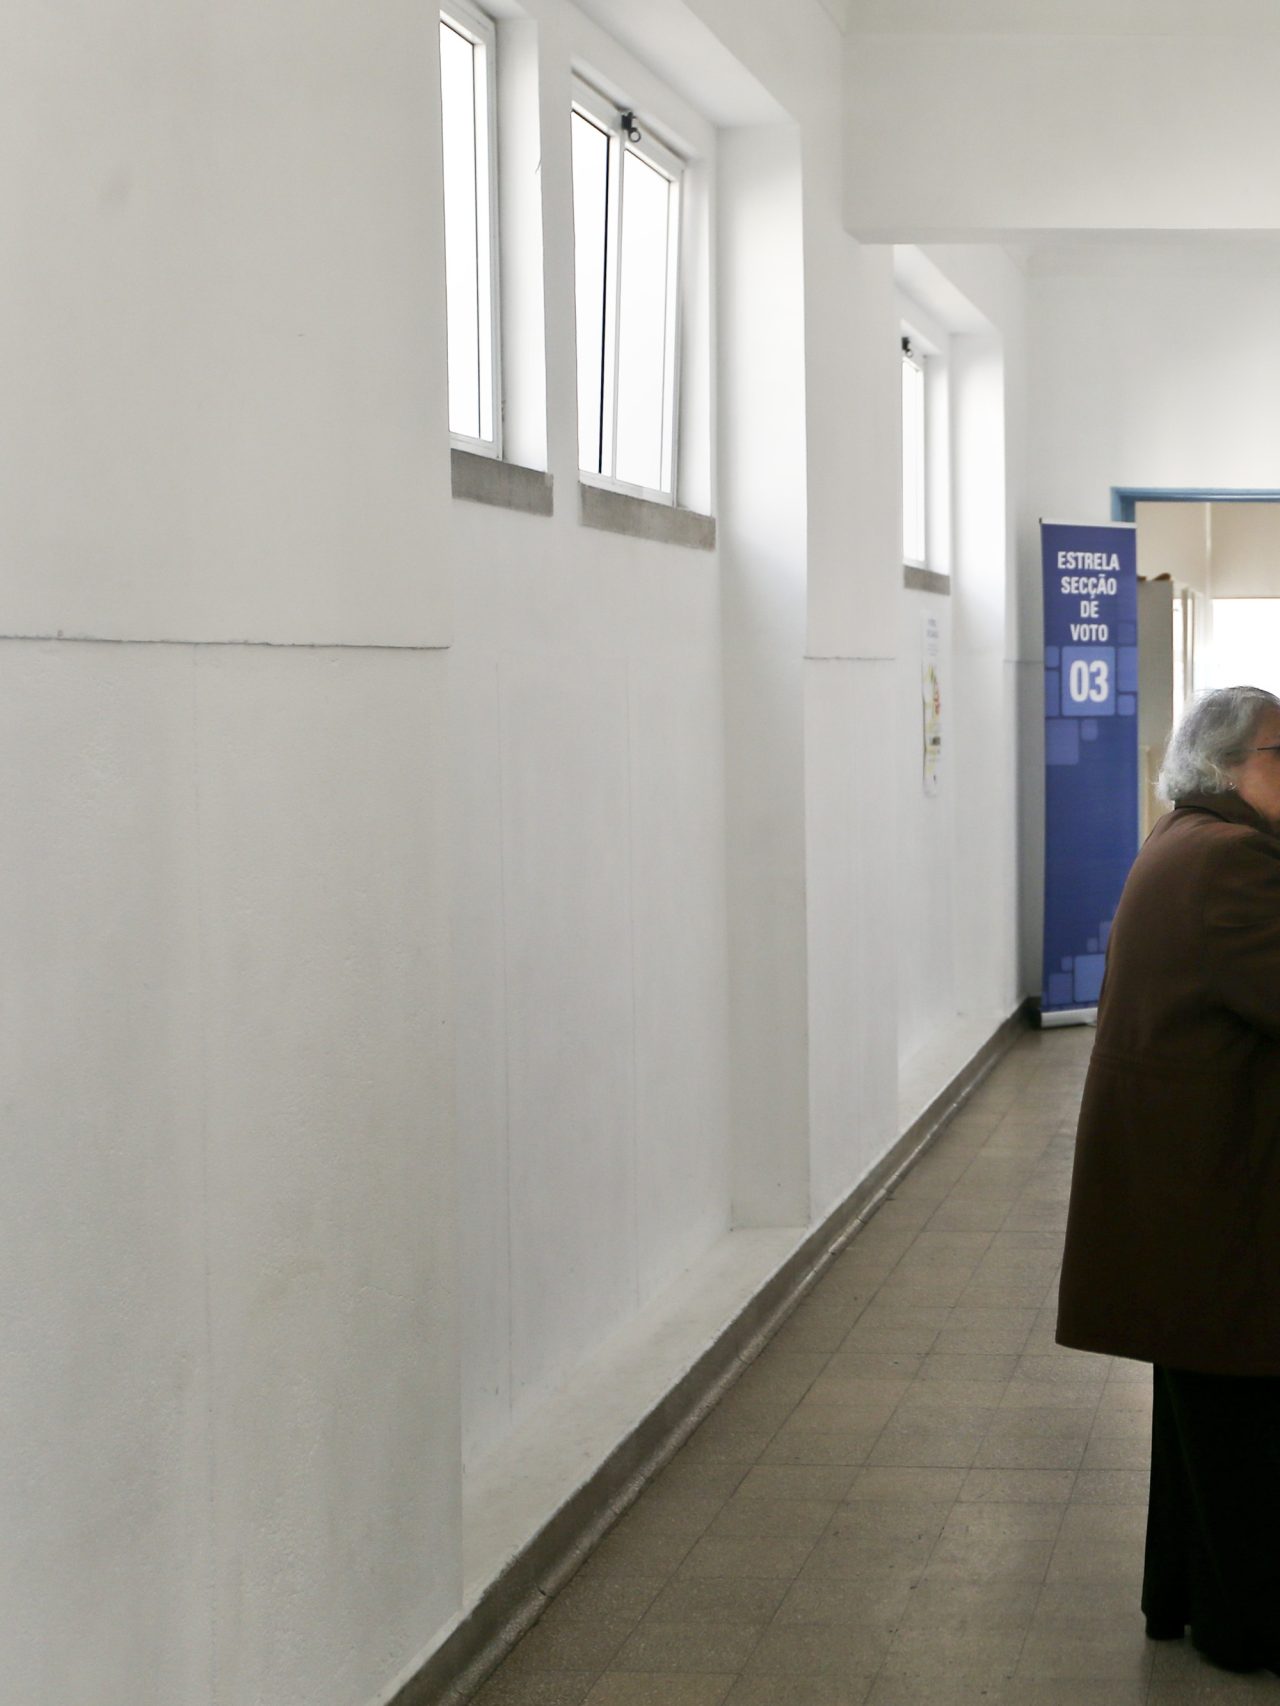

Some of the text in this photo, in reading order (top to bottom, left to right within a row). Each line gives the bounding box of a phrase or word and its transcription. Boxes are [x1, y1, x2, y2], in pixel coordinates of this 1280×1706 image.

[1057, 551, 1120, 571] ESTRELA
[1060, 574, 1117, 599] SECÇÃO
[1080, 600, 1099, 618] DE
[1070, 623, 1108, 642] VOTO
[1069, 659, 1108, 703] 03
